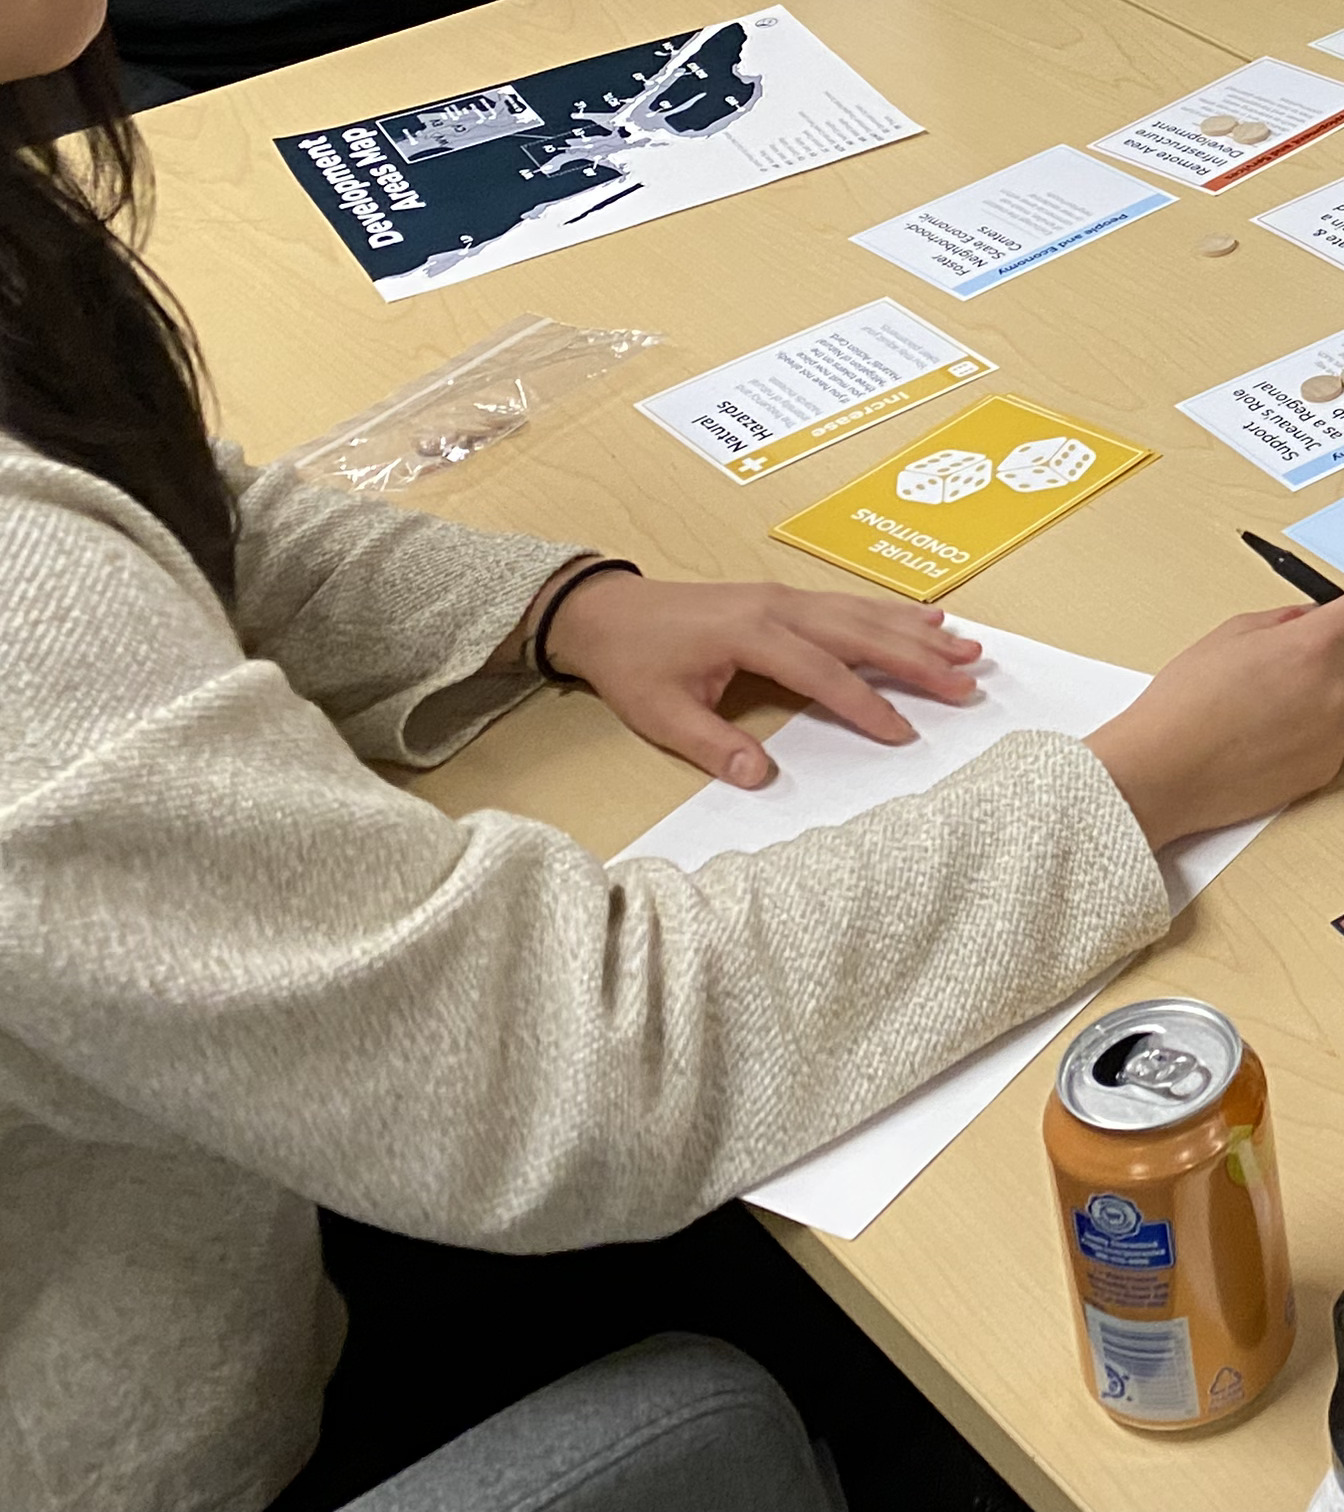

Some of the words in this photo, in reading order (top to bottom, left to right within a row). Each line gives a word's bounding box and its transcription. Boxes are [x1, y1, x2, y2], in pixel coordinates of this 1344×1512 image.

[337, 125, 391, 167] Map
[1120, 138, 1157, 154] Area
[1132, 128, 1228, 166] Infrastructure
[1149, 120, 1246, 158] Development
[1153, 151, 1212, 175] Remote
[297, 135, 405, 248] Development
[366, 162, 427, 212] Areas
[916, 212, 975, 243] Economic
[975, 225, 1023, 251] Centers
[1057, 233, 1083, 247] and
[1083, 213, 1128, 234] People
[902, 222, 989, 267] Neighborhood-
[970, 240, 1006, 259] Scale
[996, 245, 1058, 275] Economy
[929, 254, 971, 276] Foster
[810, 390, 909, 437] Increase
[1230, 388, 1265, 411] Role
[1252, 380, 1317, 421] Regional
[691, 414, 748, 452] Natural
[714, 400, 774, 441] Hazards
[1258, 408, 1322, 451] Juneau's
[1240, 421, 1300, 461] Support
[849, 507, 972, 563] CONDITIONS
[867, 539, 950, 578] FUTURE
